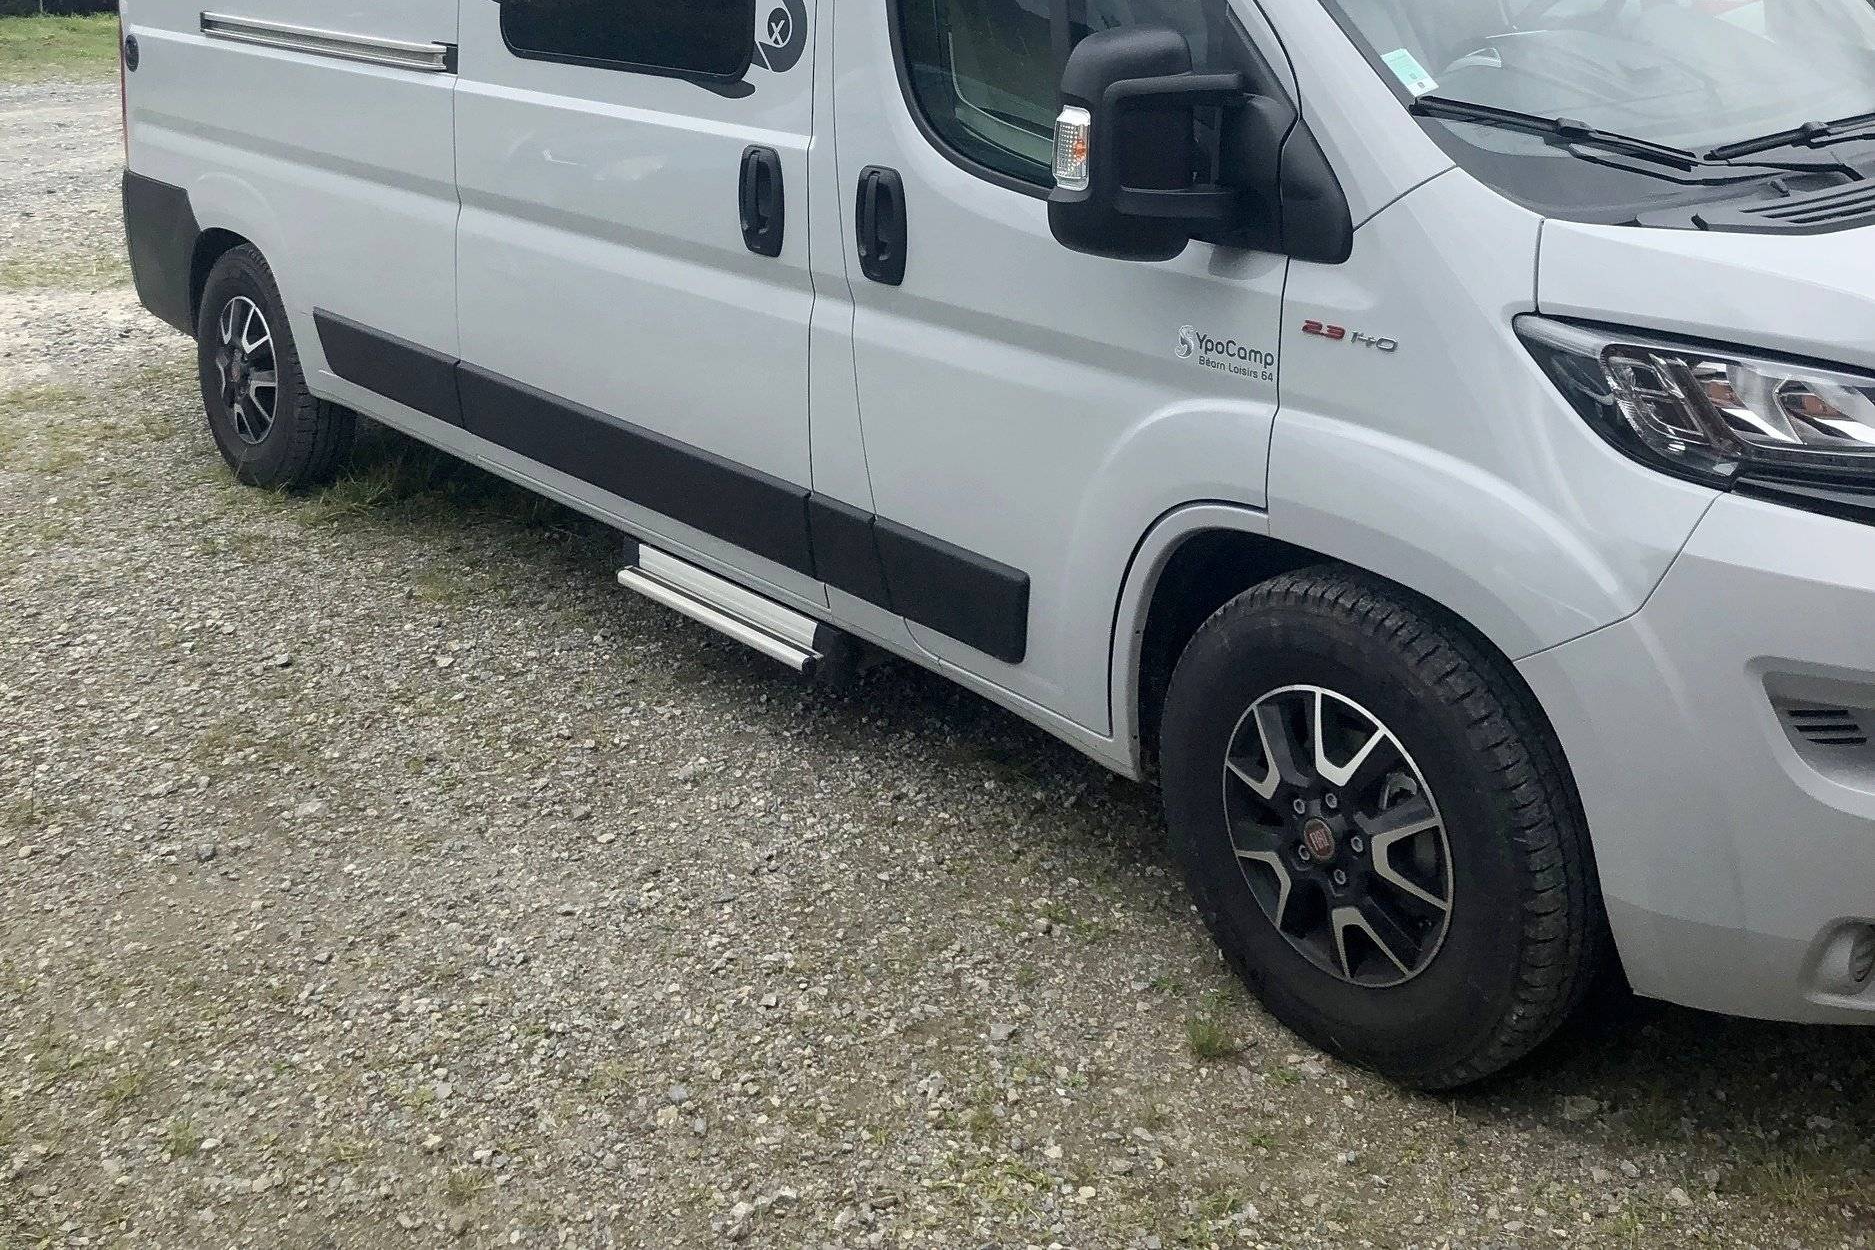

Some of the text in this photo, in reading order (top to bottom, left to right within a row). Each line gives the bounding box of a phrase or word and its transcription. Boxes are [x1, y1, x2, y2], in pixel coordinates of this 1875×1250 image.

[1195, 331, 1275, 369] YpoCamp
[1198, 355, 1274, 382] Béarn Loisirs 64
